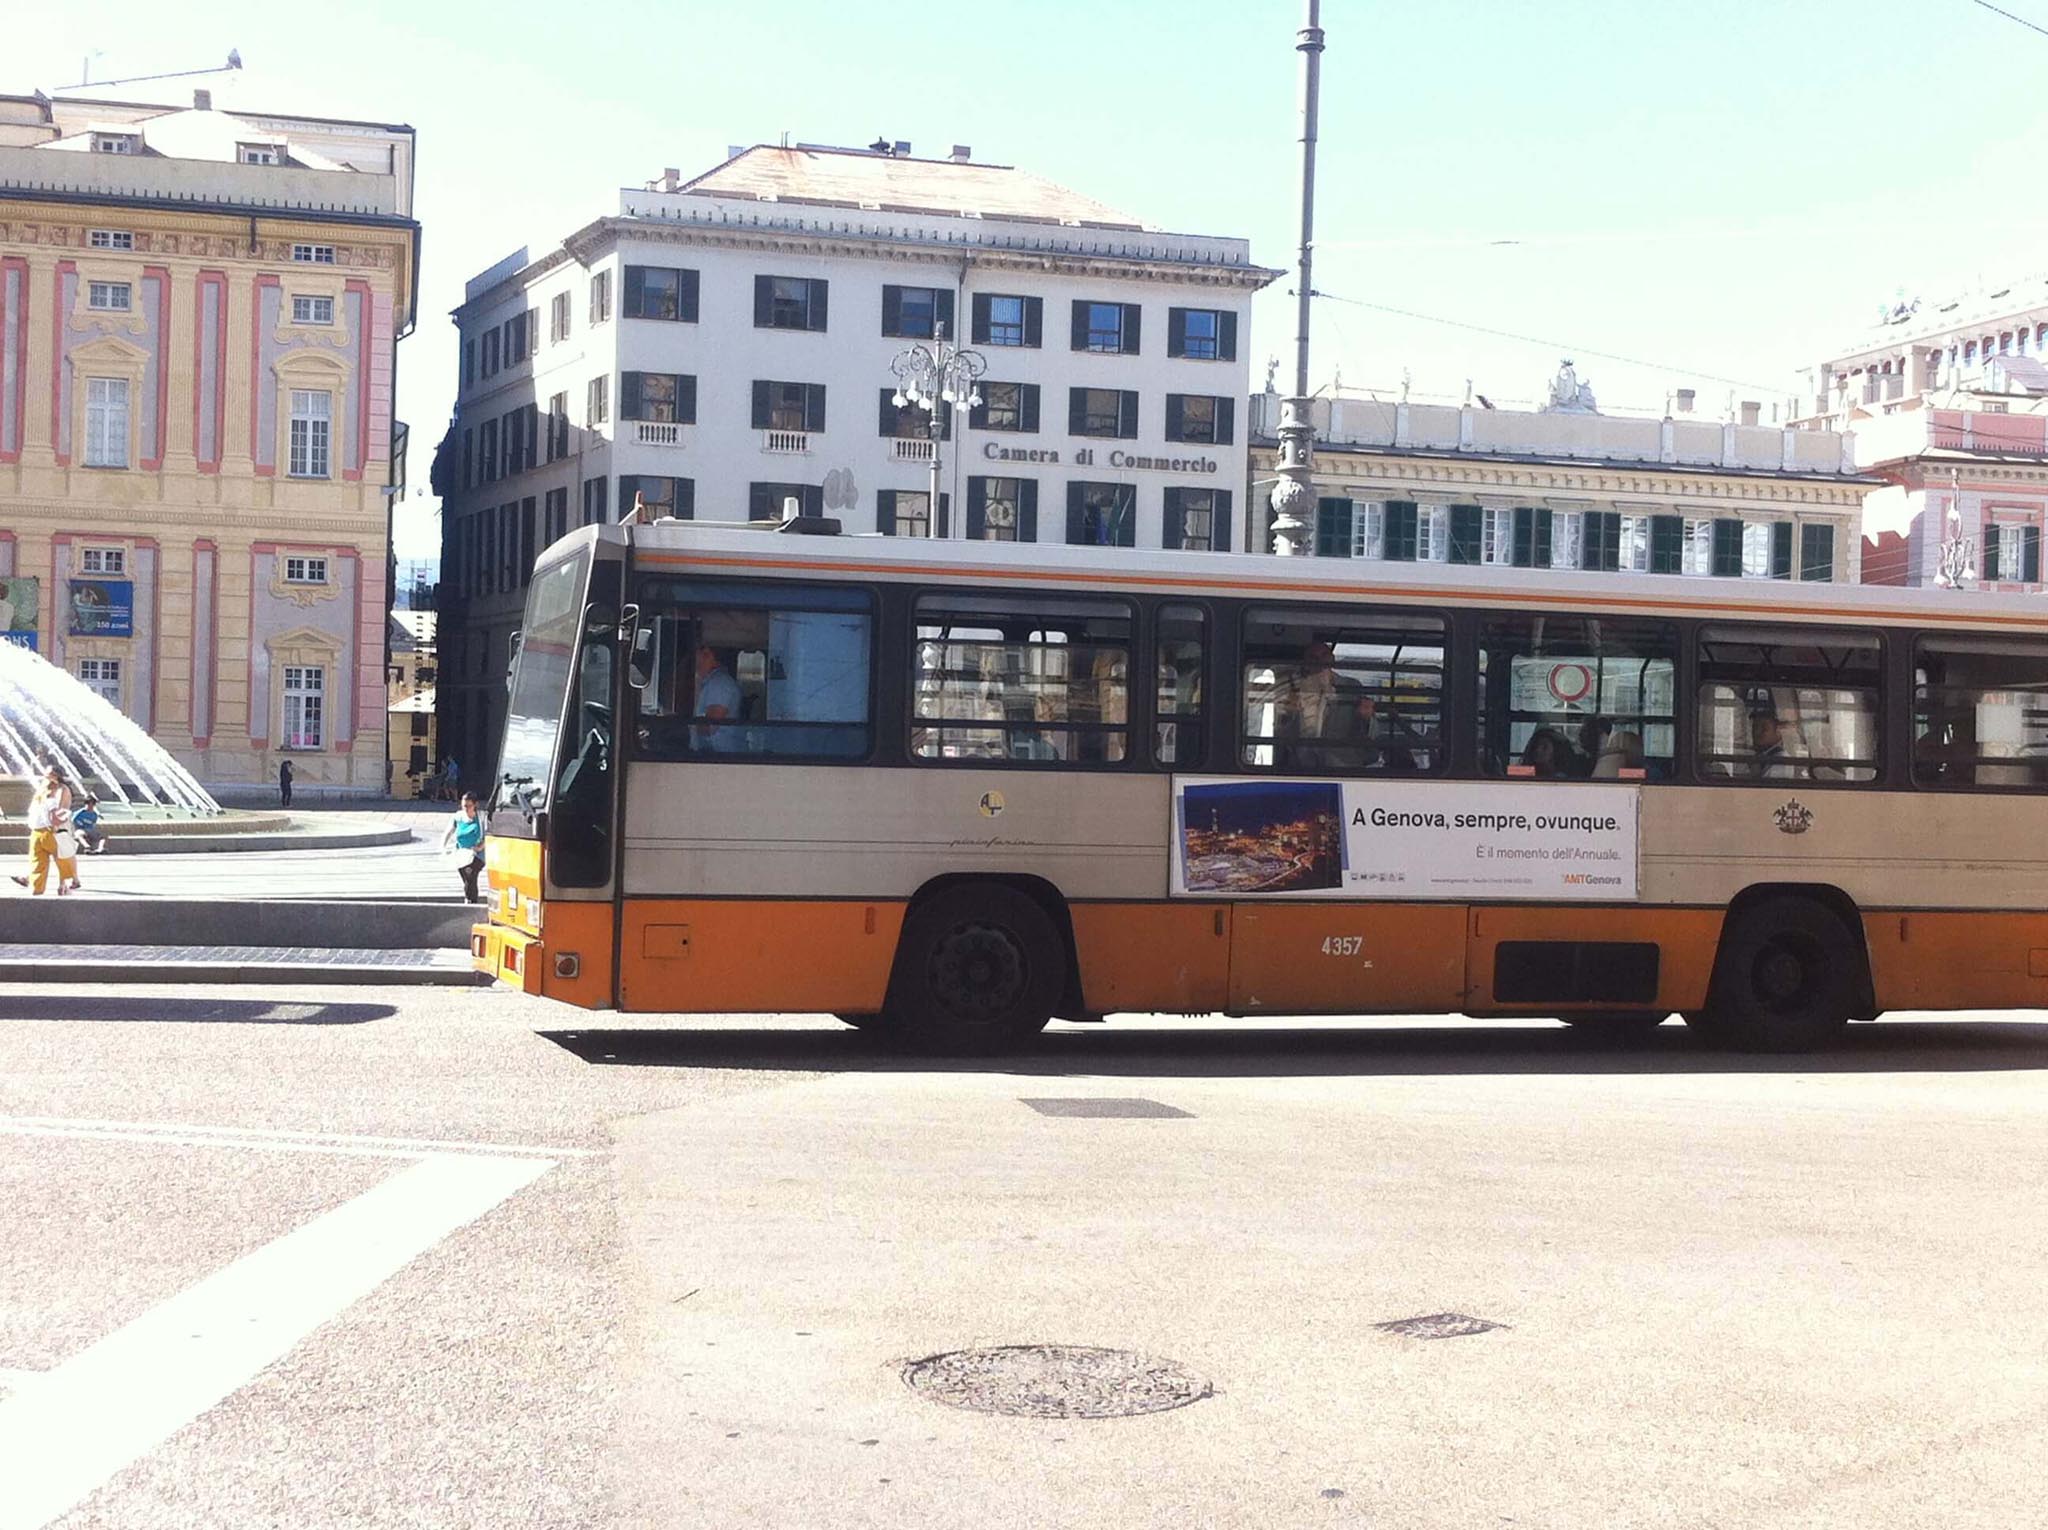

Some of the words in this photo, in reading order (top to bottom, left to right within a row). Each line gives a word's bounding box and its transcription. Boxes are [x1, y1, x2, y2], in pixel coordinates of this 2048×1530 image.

[983, 442, 1060, 463] Camera
[1075, 448, 1094, 466] di
[1109, 450, 1218, 474] Commercio
[1352, 807, 1367, 826] A
[1371, 808, 1451, 830] Genova,
[1454, 813, 1532, 832] sempre,
[1535, 815, 1622, 833] ovunque.
[1487, 846, 1494, 859] il
[1496, 848, 1549, 860] momento
[1551, 847, 1622, 861] dell'Annuale.
[1321, 936, 1363, 956] 4357
